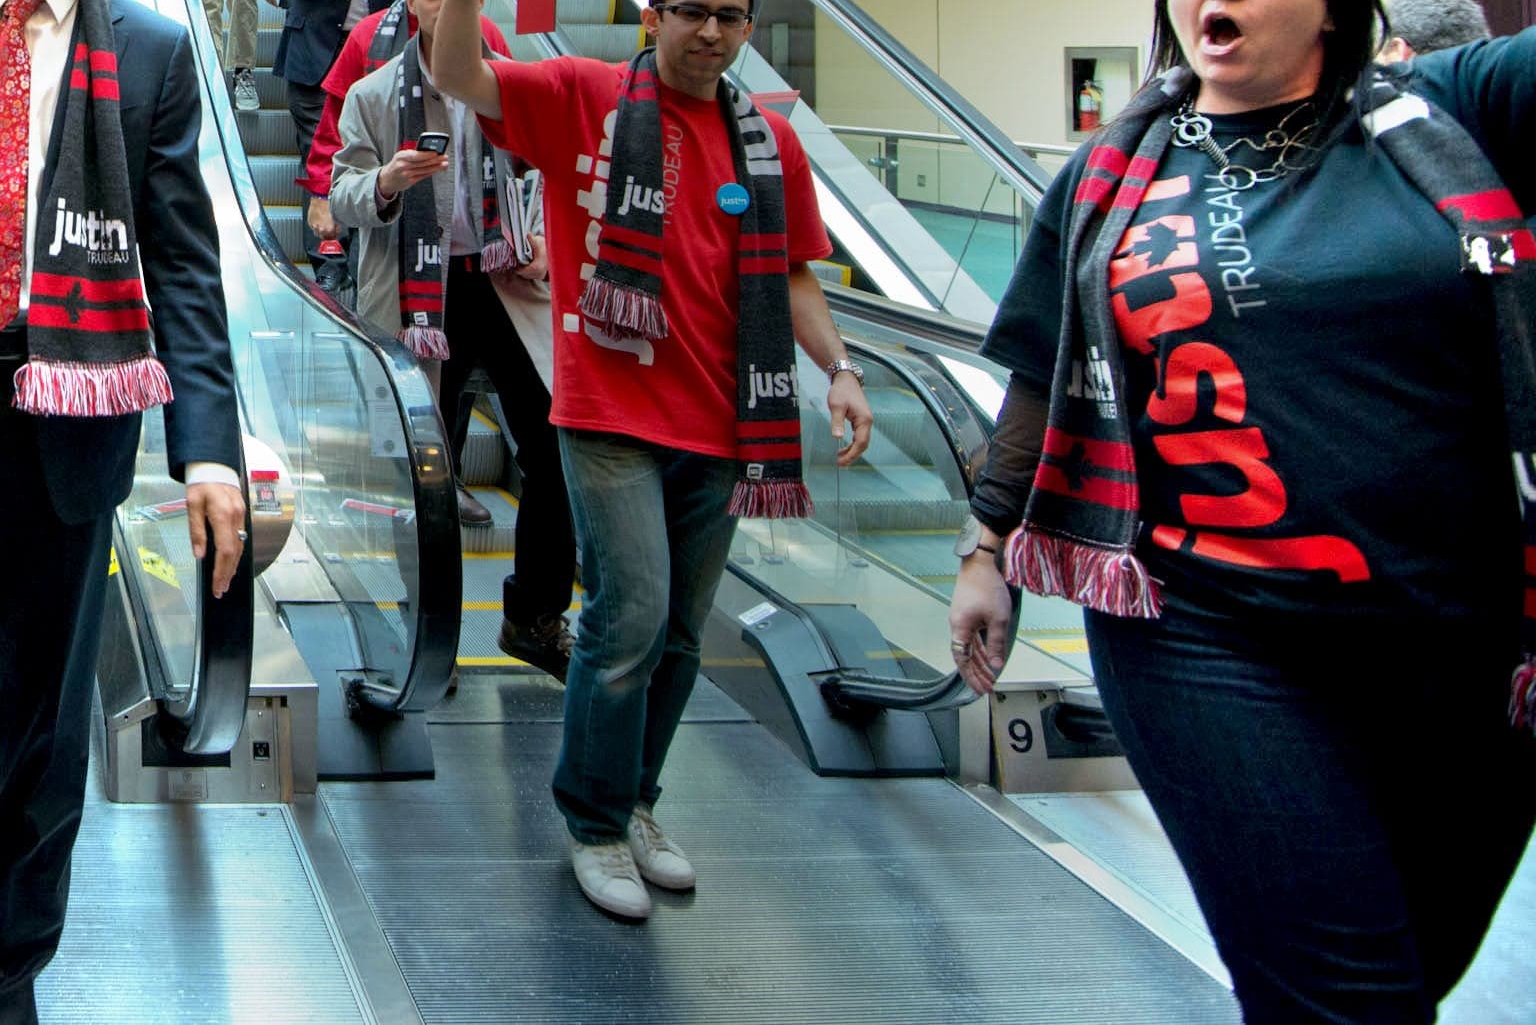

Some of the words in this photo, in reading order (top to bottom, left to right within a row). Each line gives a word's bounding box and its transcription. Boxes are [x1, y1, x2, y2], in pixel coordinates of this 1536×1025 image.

[720, 196, 747, 207] justin
[48, 196, 129, 256] justin
[86, 249, 130, 265] TRUDEAU
[1203, 174, 1268, 319] TRUDEAU
[1007, 717, 1034, 753] 9
